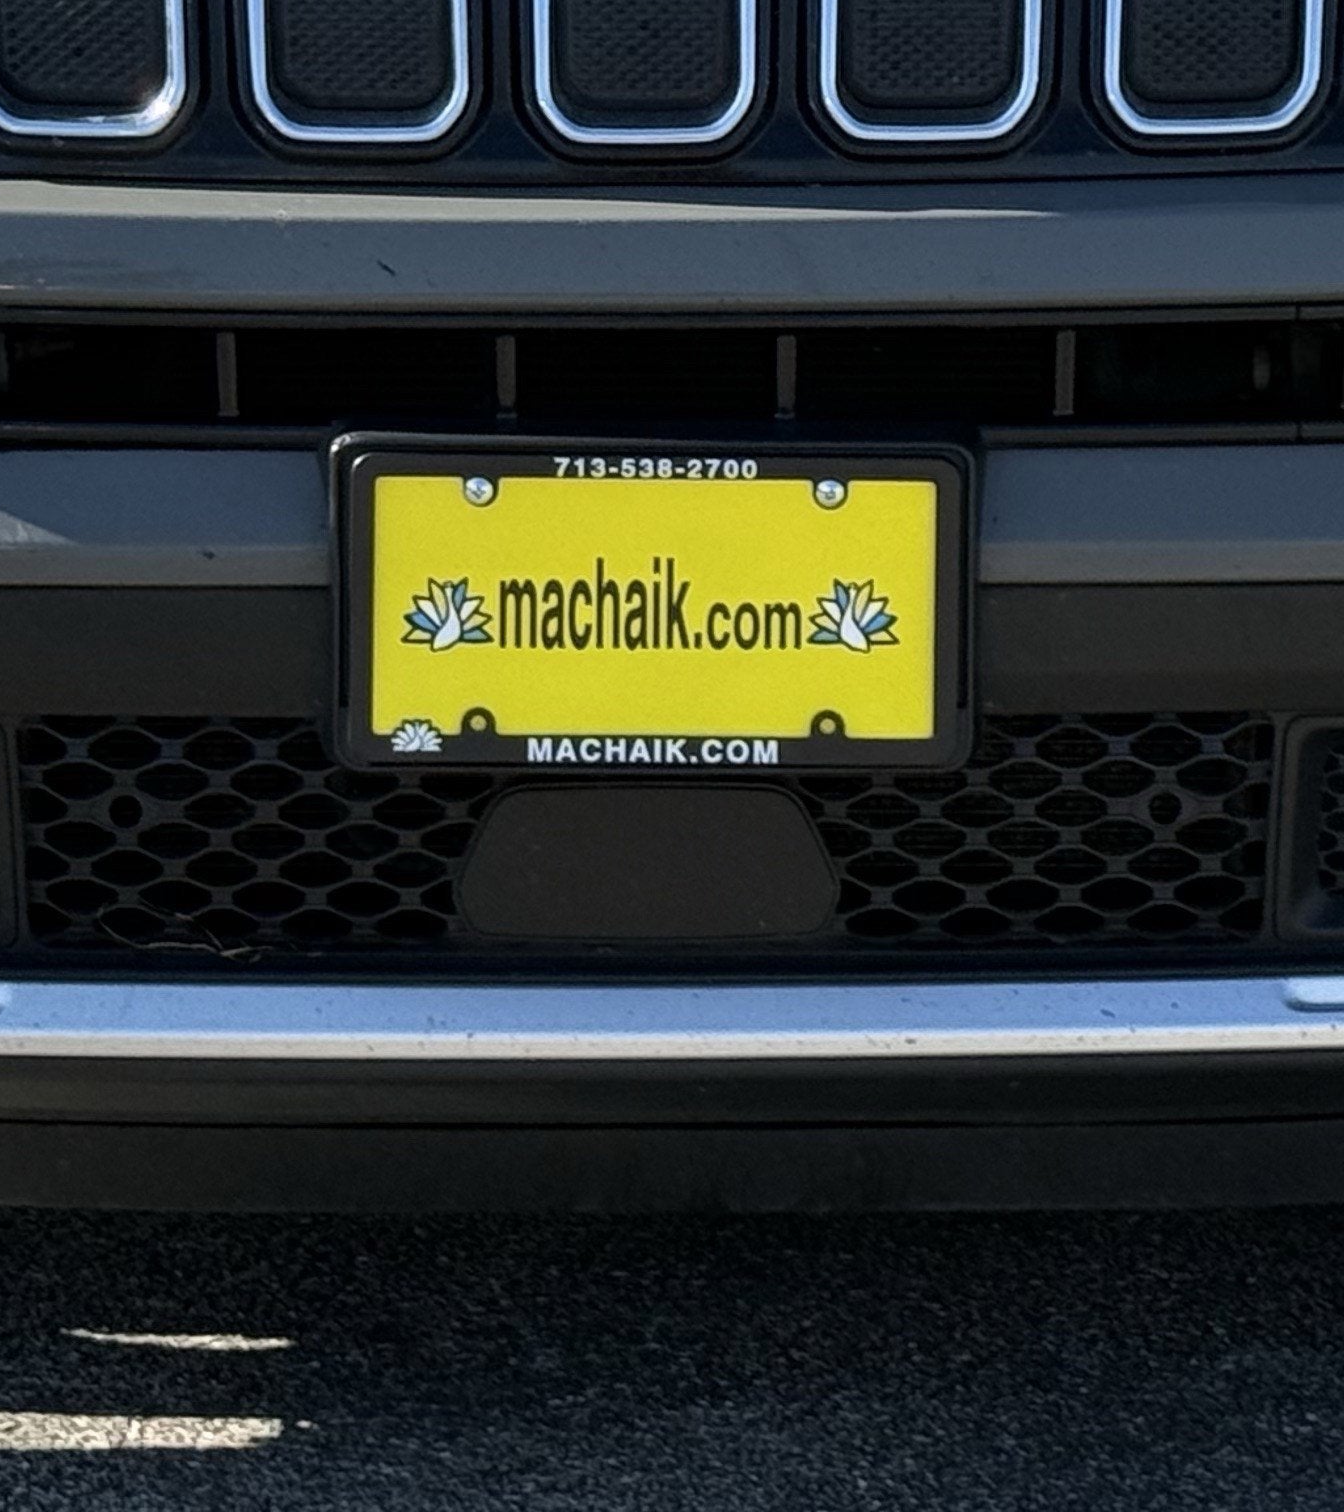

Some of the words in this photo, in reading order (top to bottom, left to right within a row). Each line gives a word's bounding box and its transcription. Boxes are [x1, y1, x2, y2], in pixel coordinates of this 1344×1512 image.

[553, 456, 759, 480] 713-538-2700
[498, 556, 803, 651] machaik.com
[526, 736, 780, 765] MACHAIK.COM
